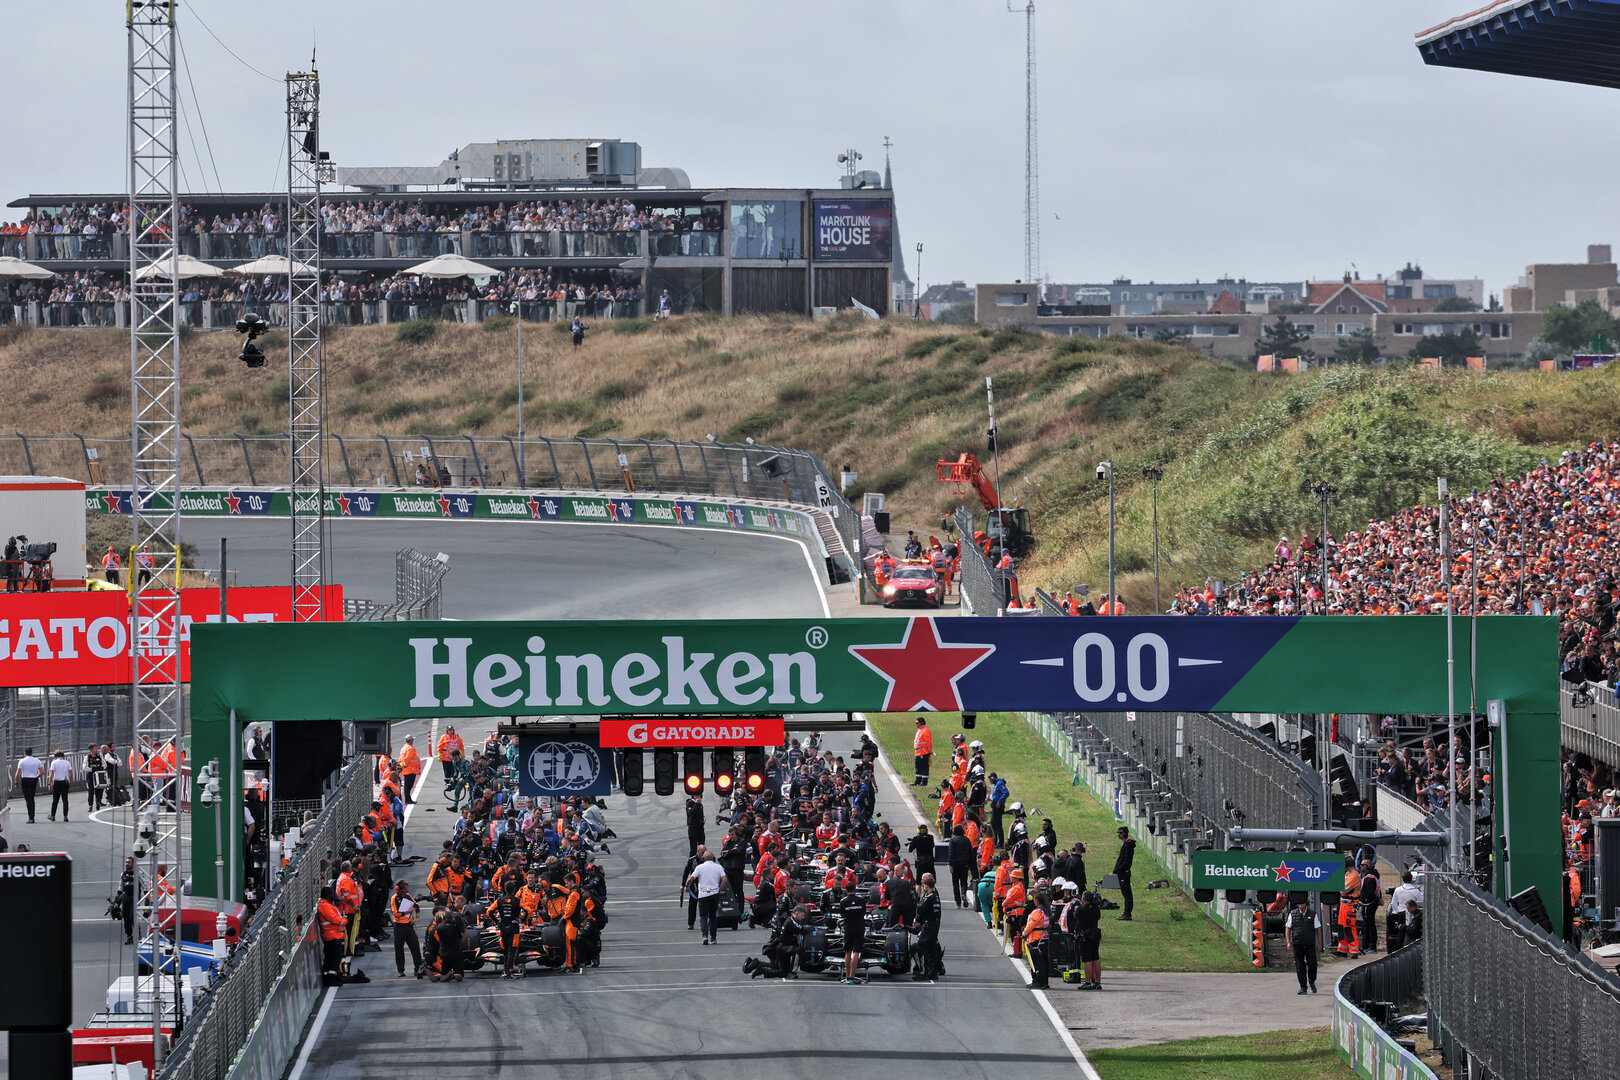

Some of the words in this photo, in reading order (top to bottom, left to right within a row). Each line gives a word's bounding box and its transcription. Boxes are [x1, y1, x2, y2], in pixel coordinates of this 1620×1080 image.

[820, 215, 871, 226] MARKTLINK
[820, 227, 871, 245] HOUSE
[819, 485, 828, 496] S
[393, 497, 437, 513] Heineken
[488, 499, 528, 515] Heineken
[820, 497, 832, 507] M
[408, 635, 824, 709] Heineken
[1072, 632, 1170, 703] 0.0
[652, 726, 756, 740] GATORADE
[0, 864, 56, 878] Heuer
[1204, 864, 1269, 877] Heineken
[1304, 866, 1321, 879] 0.0
